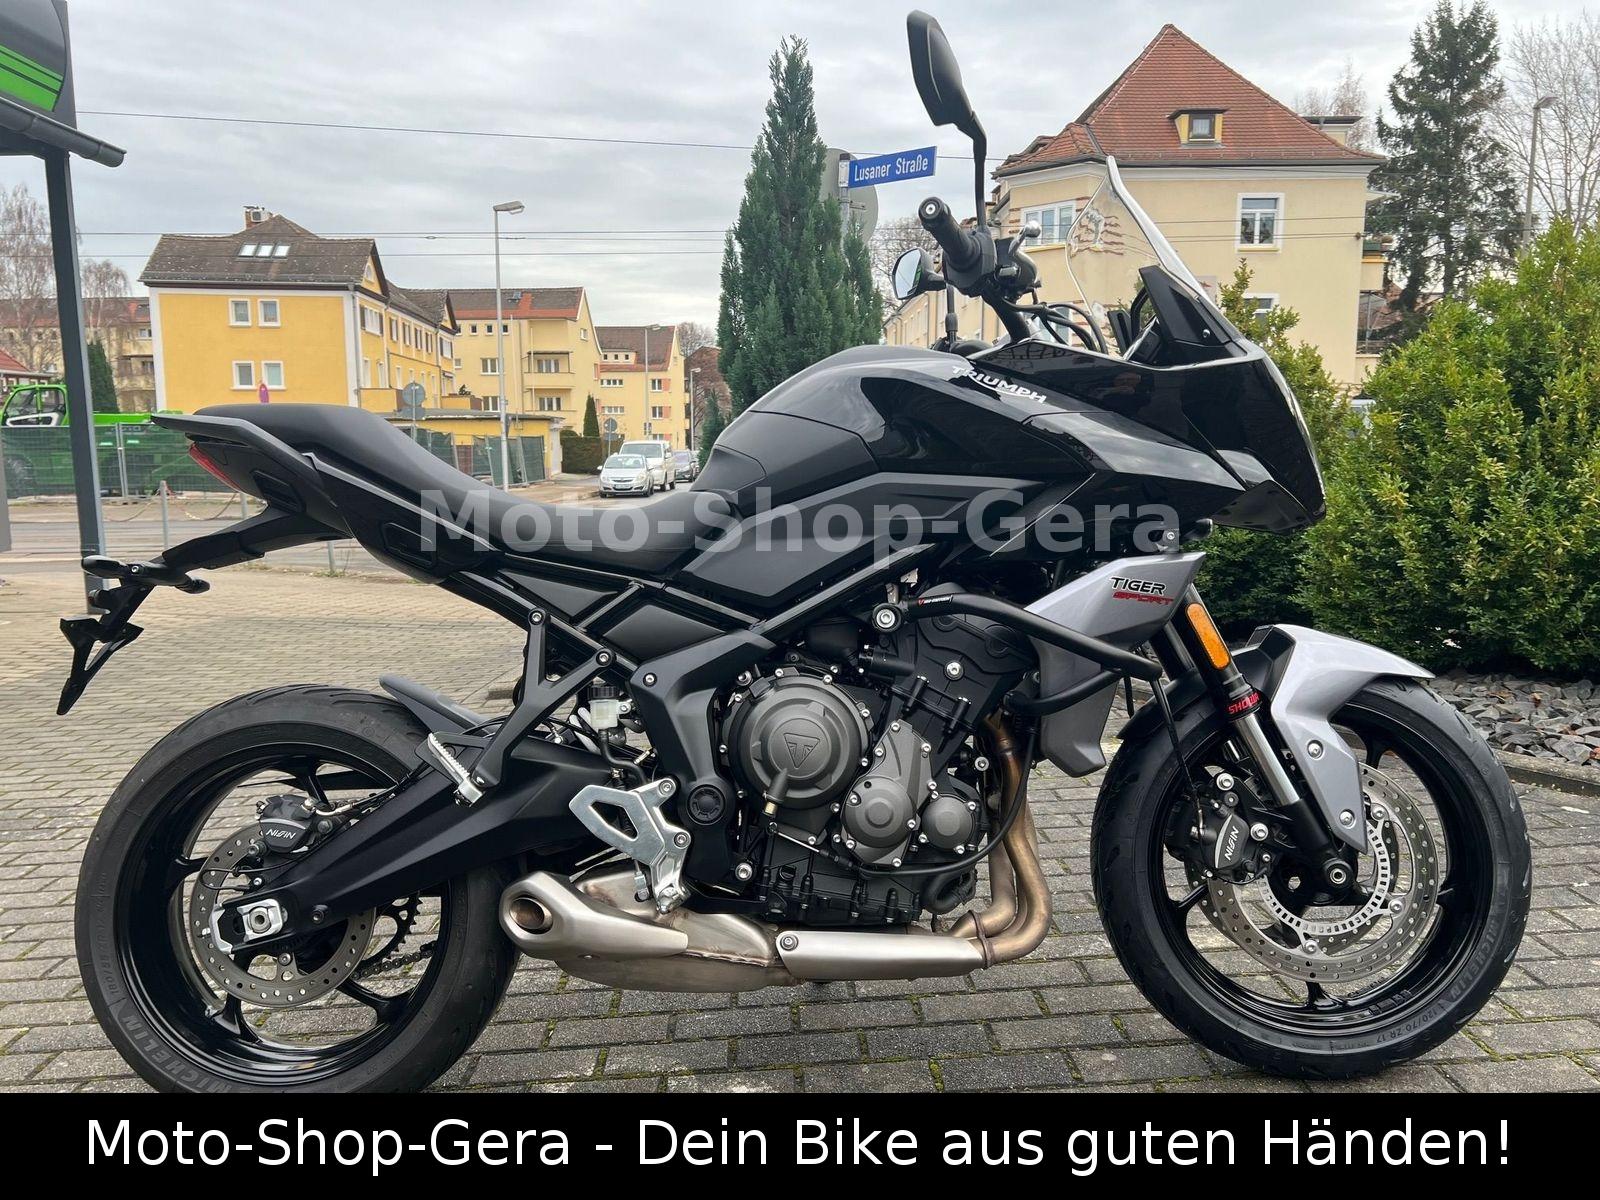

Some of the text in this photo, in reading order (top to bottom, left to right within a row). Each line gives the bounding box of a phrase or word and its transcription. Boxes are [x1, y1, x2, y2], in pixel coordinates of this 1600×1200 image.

[854, 154, 928, 182] Lusaner Straße
[952, 365, 1047, 403] TRIUMPH
[1110, 576, 1166, 596] TIGER
[1228, 692, 1260, 715] SHOWA
[122, 1014, 233, 1094] MICHELIN
